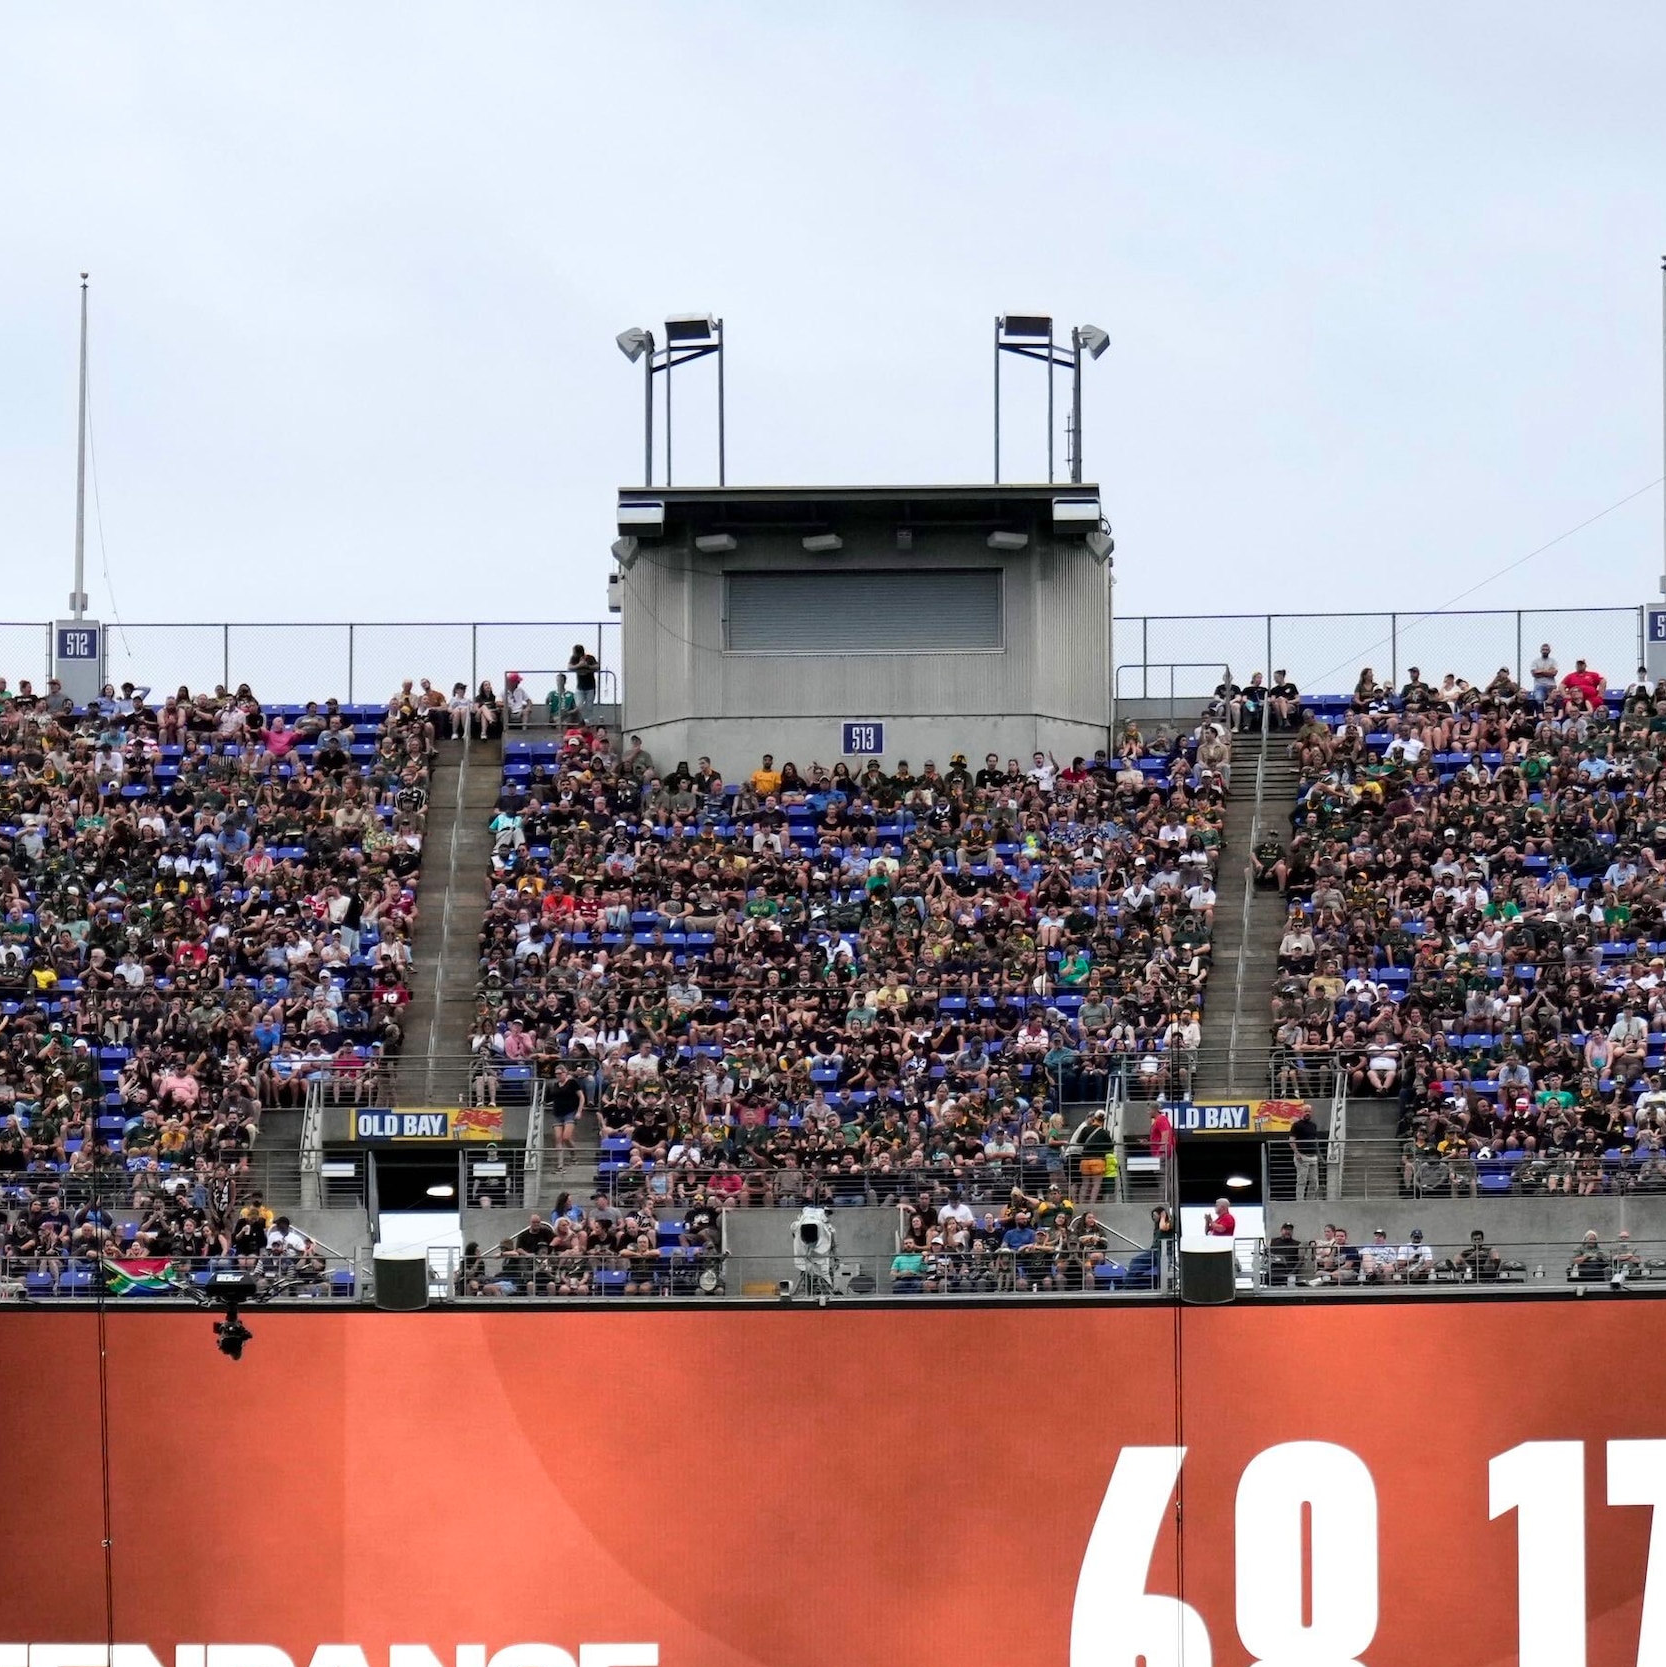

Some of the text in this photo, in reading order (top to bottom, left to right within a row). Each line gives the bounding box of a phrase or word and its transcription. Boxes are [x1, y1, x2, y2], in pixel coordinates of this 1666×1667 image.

[67, 632, 88, 655] 512
[852, 727, 874, 751] 513
[358, 1114, 444, 1137] OLD BAY
[1203, 1108, 1246, 1130] BAY
